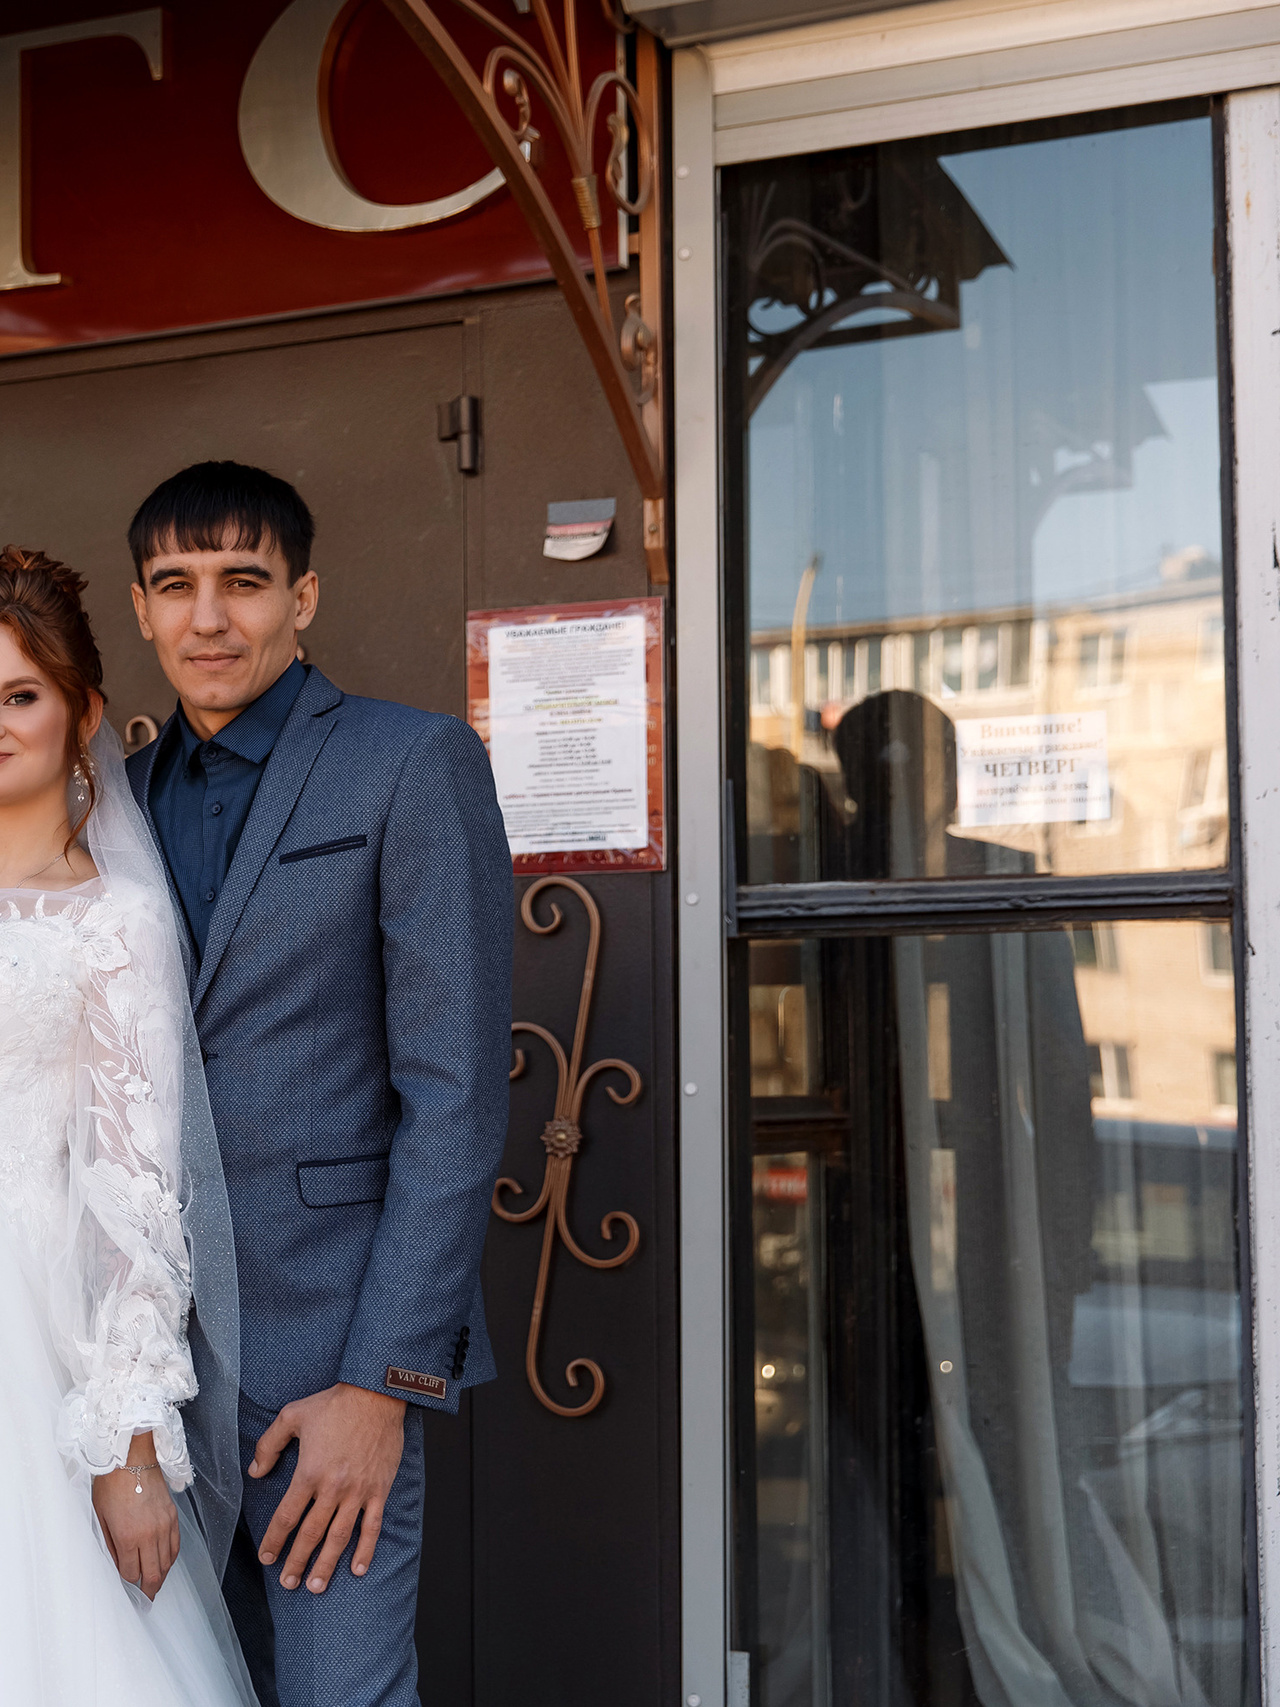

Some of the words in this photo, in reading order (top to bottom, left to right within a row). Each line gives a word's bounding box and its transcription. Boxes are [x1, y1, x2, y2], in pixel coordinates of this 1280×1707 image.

[980, 718, 1082, 740] Внимание!
[984, 758, 1082, 778] ЧЕТВЕРГ
[398, 1371, 415, 1382] VAN
[418, 1376, 440, 1388] CLIFF
